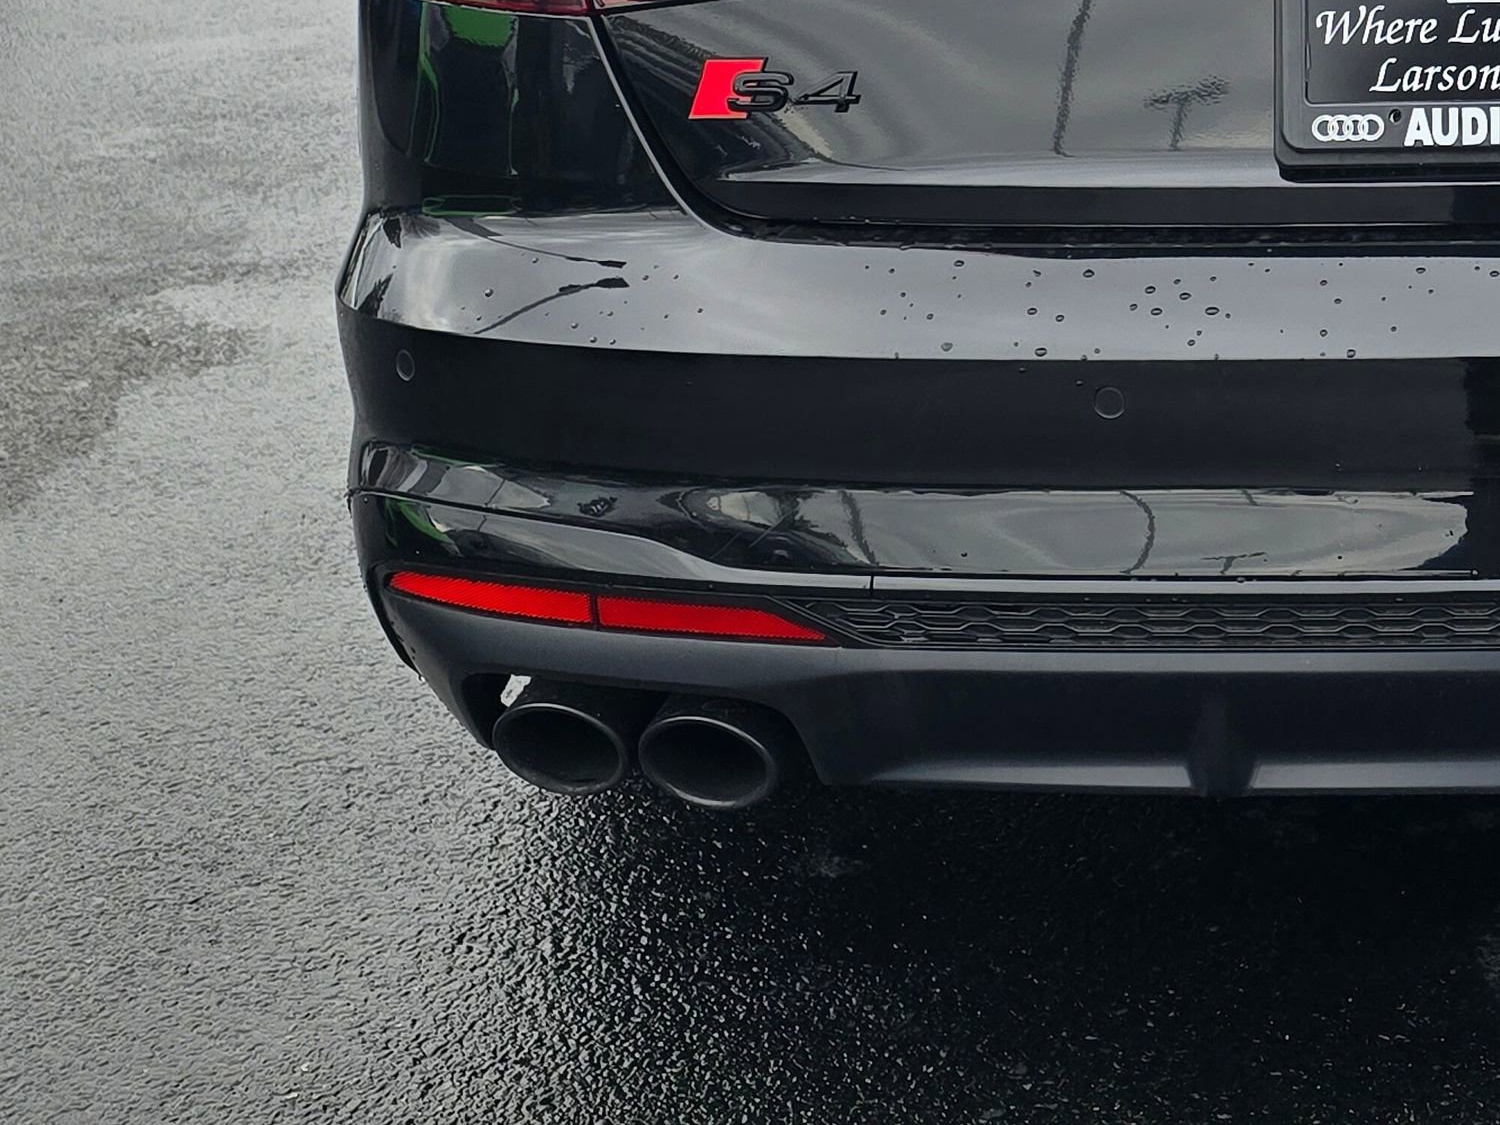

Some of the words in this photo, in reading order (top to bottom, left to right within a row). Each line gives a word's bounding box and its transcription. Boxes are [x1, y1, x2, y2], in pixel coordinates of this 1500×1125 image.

[1315, 4, 1439, 46] Where
[727, 70, 861, 113] S4
[1403, 106, 1500, 146] AUDI
